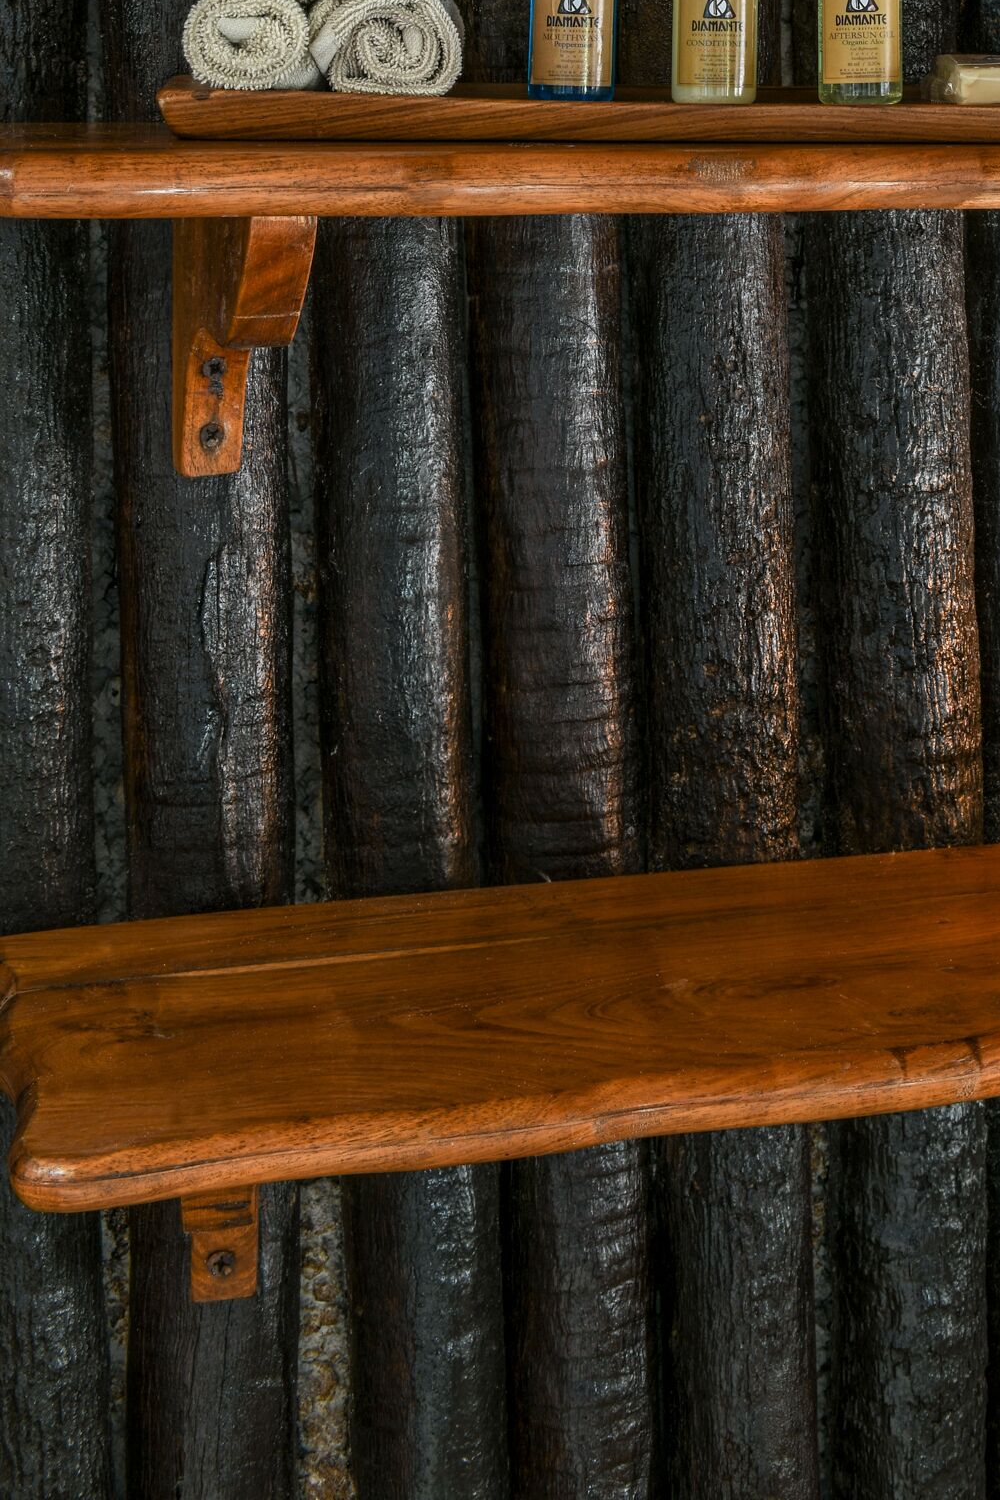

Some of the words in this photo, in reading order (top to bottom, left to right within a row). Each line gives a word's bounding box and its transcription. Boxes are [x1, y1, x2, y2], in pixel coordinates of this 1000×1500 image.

[546, 15, 601, 28] DIAMANTE
[691, 20, 744, 31] DIAMANTE
[835, 13, 888, 26] DIAMANTE
[829, 32, 877, 40] AFTERSUN
